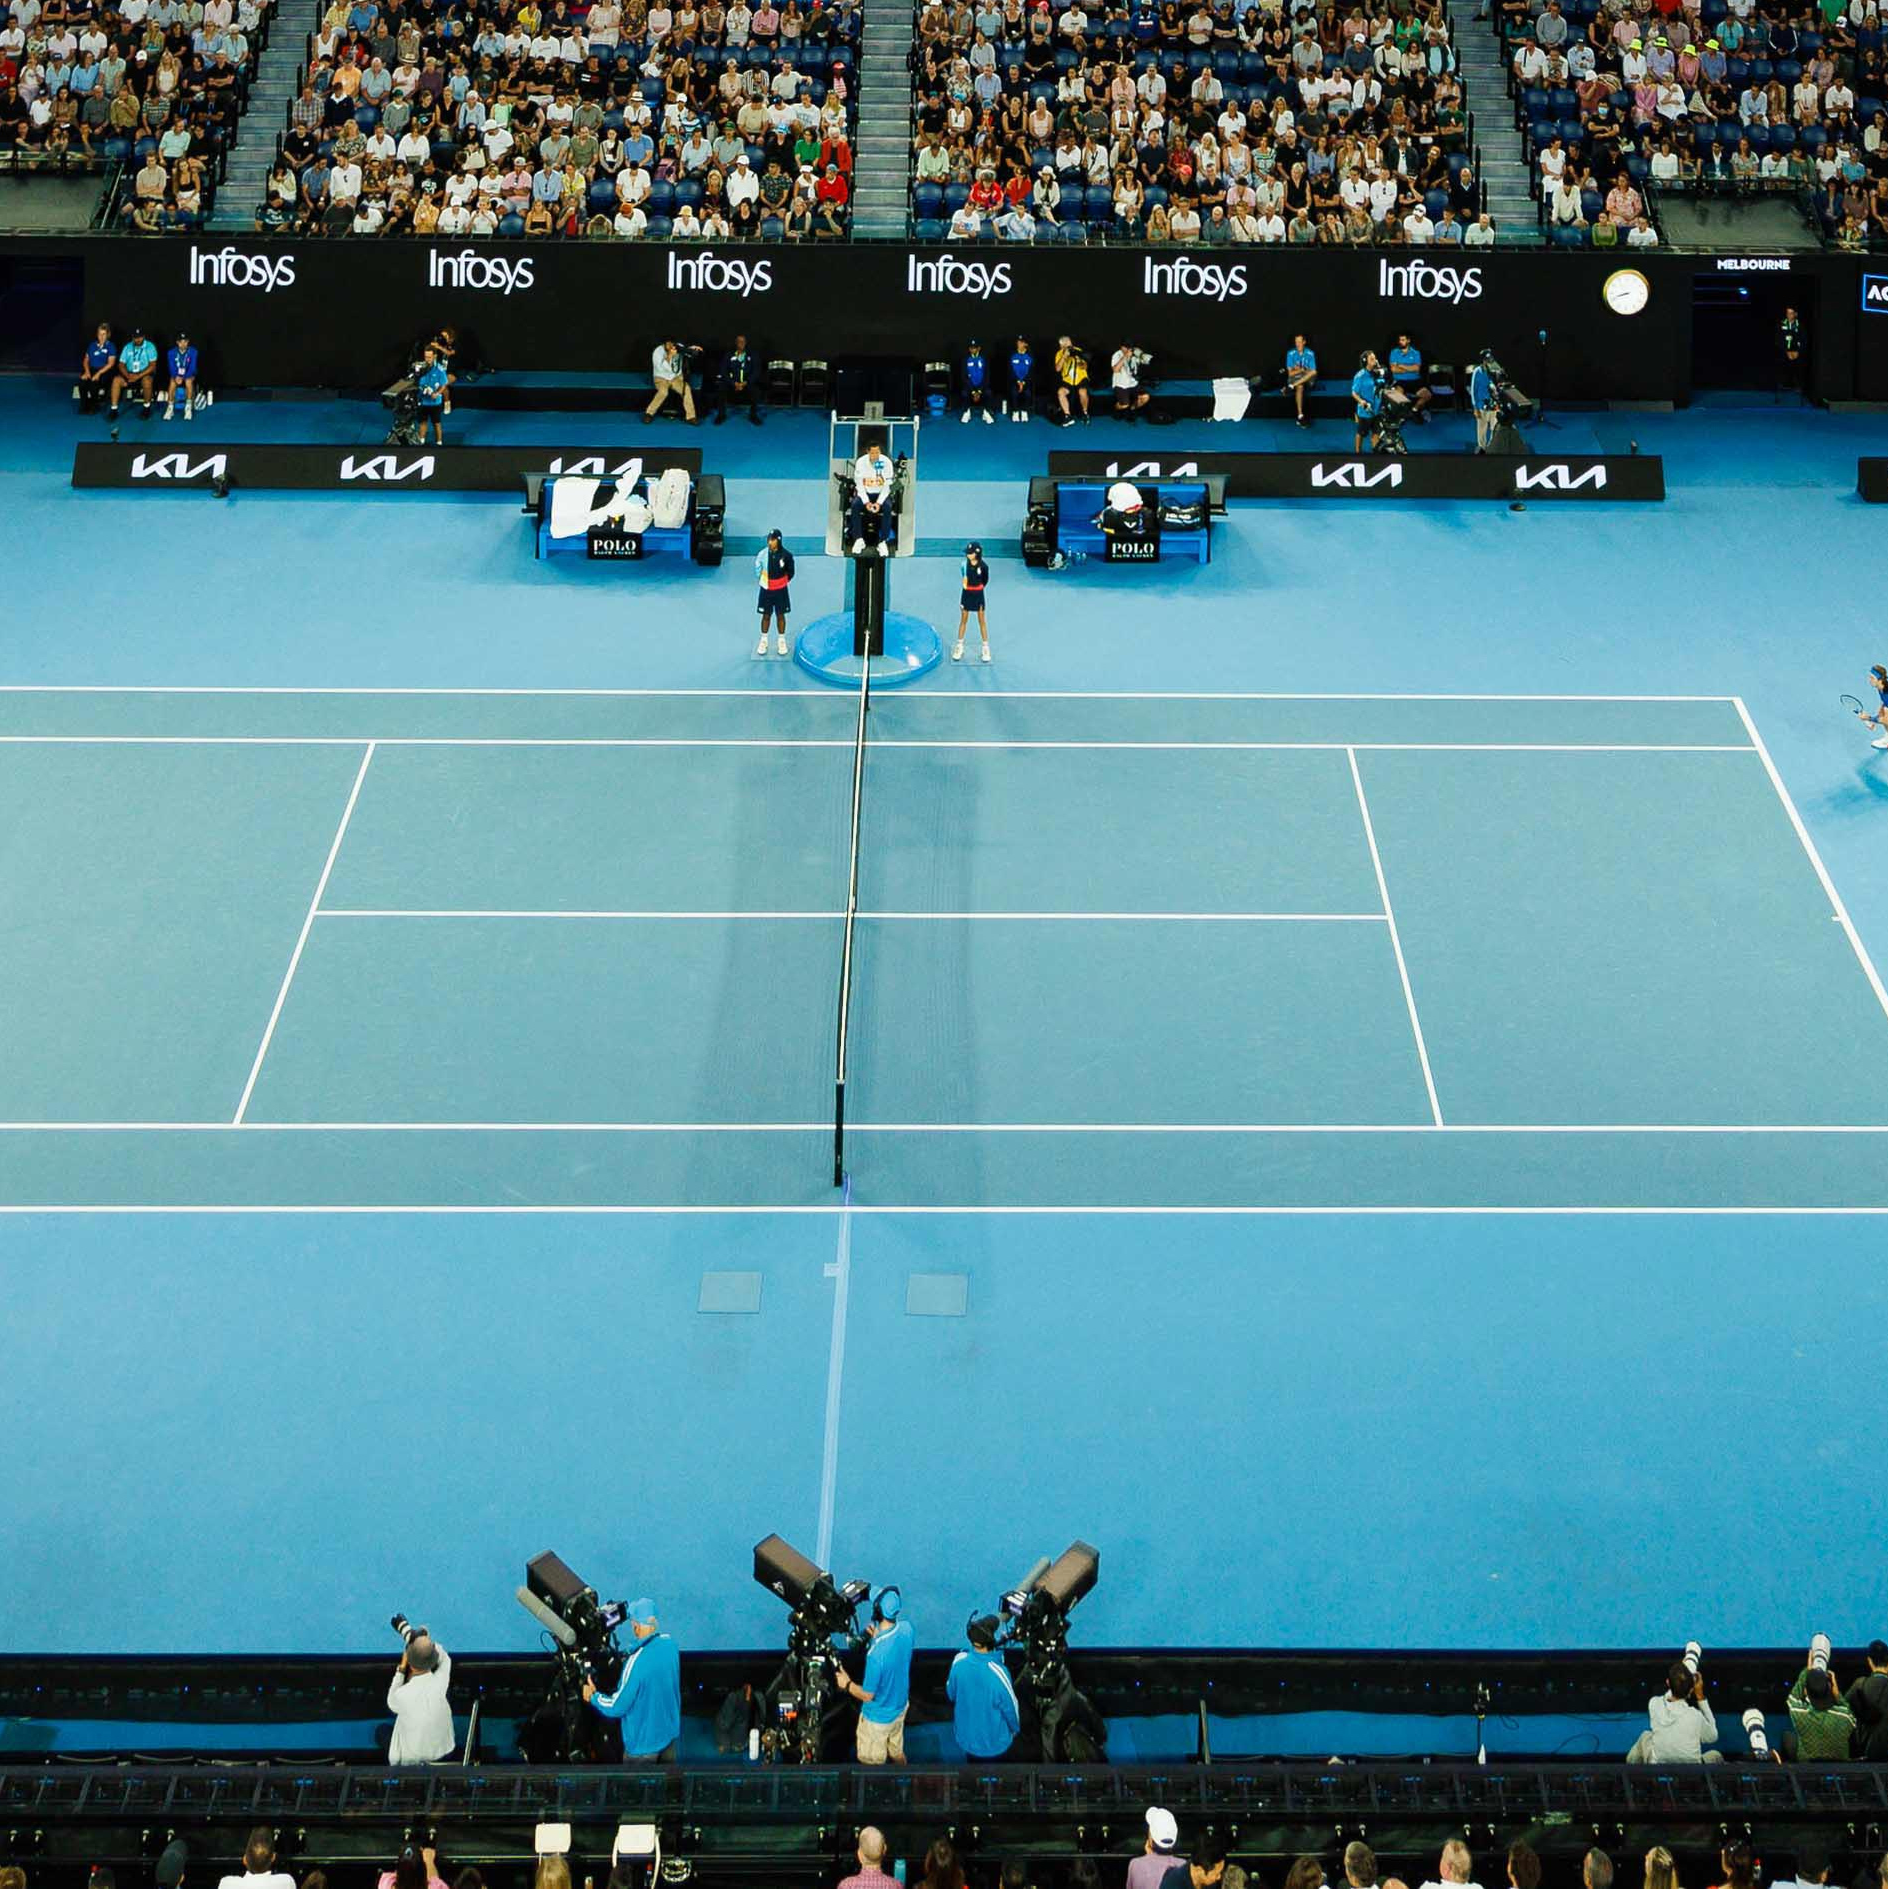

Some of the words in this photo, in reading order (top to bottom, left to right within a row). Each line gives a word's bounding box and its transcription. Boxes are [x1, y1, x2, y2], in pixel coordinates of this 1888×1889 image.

[190, 245, 295, 293] Infosys
[430, 248, 534, 295] Infosys
[669, 250, 773, 298] Infosys
[908, 253, 1012, 300] Infosys
[1145, 256, 1248, 302] Infosys
[1380, 258, 1483, 304] Infosys
[1717, 259, 1791, 270] MELBOURNE
[593, 539, 637, 551] POLO
[1112, 542, 1154, 554] POLO
